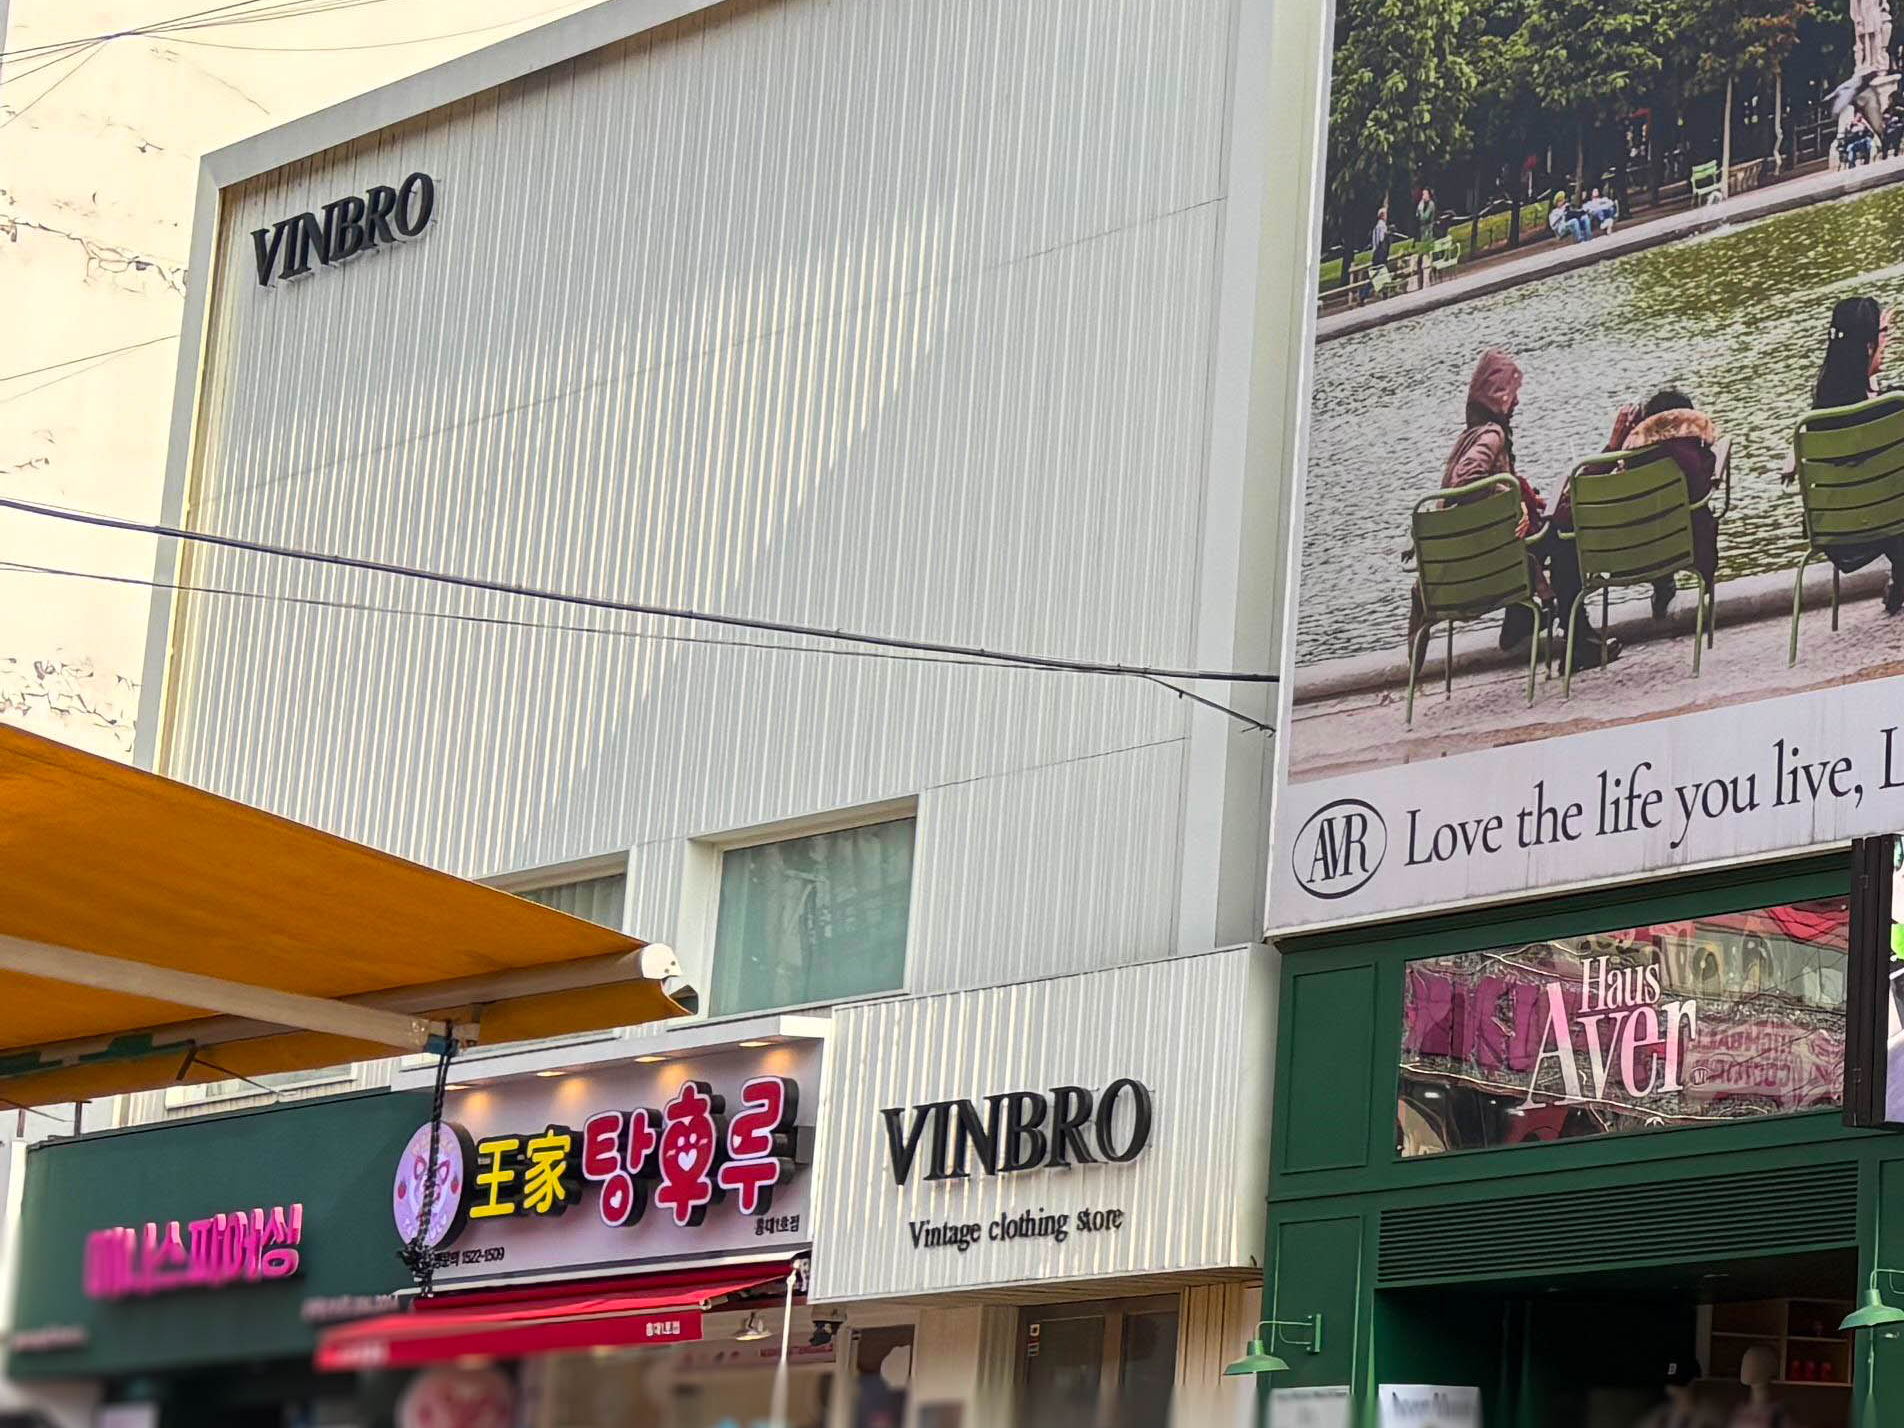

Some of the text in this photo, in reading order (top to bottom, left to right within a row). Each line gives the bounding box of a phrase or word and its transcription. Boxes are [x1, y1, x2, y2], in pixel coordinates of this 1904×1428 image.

[251, 172, 435, 286] VINBRO
[1404, 809, 1503, 866] Love
[1516, 780, 1583, 848] the
[1595, 761, 1663, 836] life
[1670, 773, 1760, 850] you
[1772, 738, 1863, 809] live,
[1580, 956, 1661, 1014] Haus
[1515, 982, 1697, 1111] Aver
[469, 1075, 785, 1228] 王家 탕후루
[881, 1077, 1153, 1187] VINBRO
[908, 1206, 1124, 1256] Vintage clothing store
